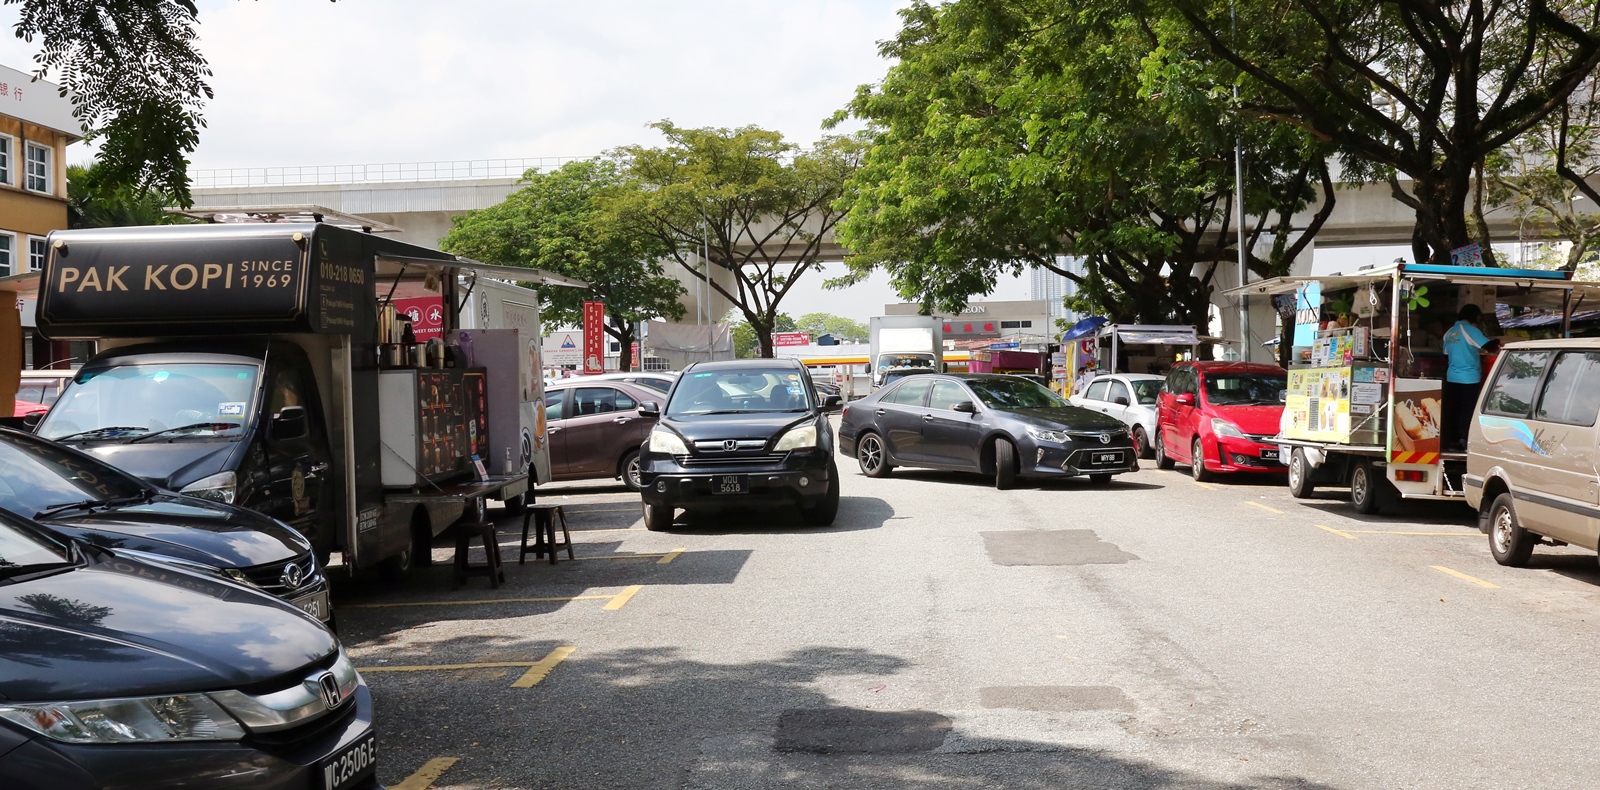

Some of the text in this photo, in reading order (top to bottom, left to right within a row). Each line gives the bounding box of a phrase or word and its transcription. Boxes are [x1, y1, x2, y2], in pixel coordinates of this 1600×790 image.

[241, 260, 293, 272] SINCE
[58, 263, 233, 293] PAK KOPI
[320, 262, 365, 285] 010-218 0650
[241, 274, 291, 288] 1969
[721, 484, 741, 493] 5618
